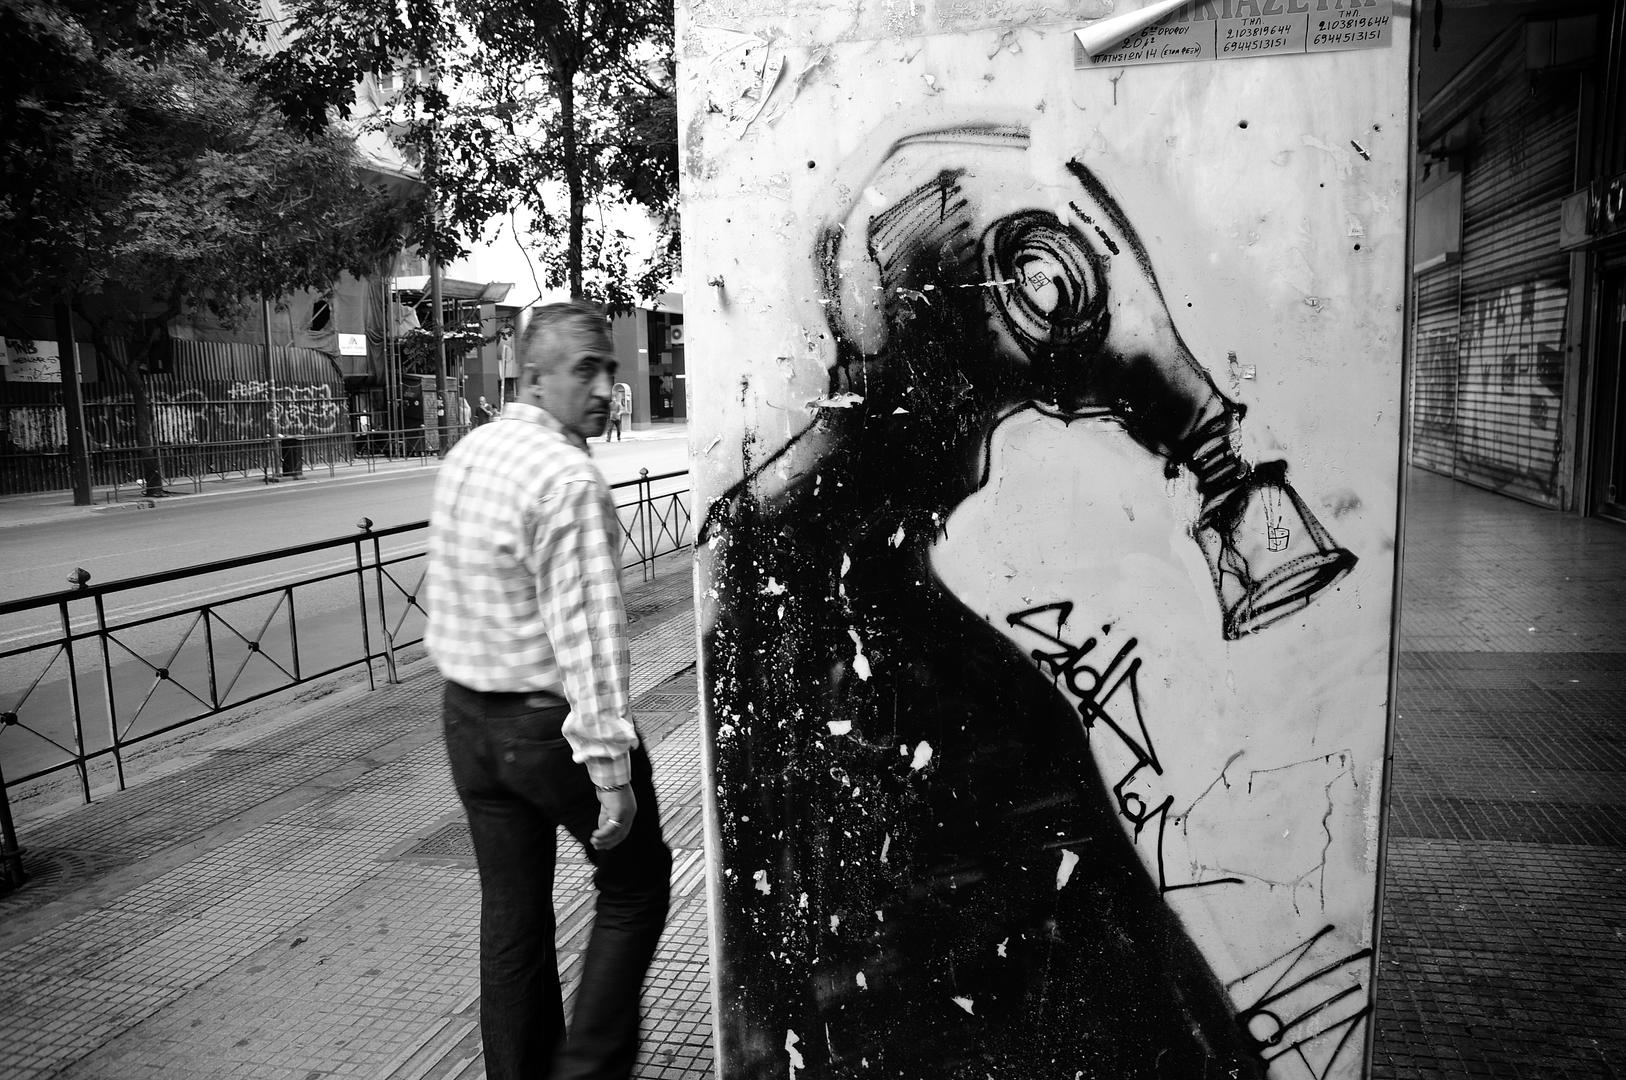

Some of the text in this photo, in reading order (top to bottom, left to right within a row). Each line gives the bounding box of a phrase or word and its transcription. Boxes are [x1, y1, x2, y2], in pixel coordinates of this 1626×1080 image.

[1318, 16, 1390, 31] 2103819644
[1226, 25, 1292, 39] 2103819644
[1313, 30, 1381, 45] 6944513151
[1223, 38, 1287, 52] 6944513151
[1145, 48, 1157, 59] 14
